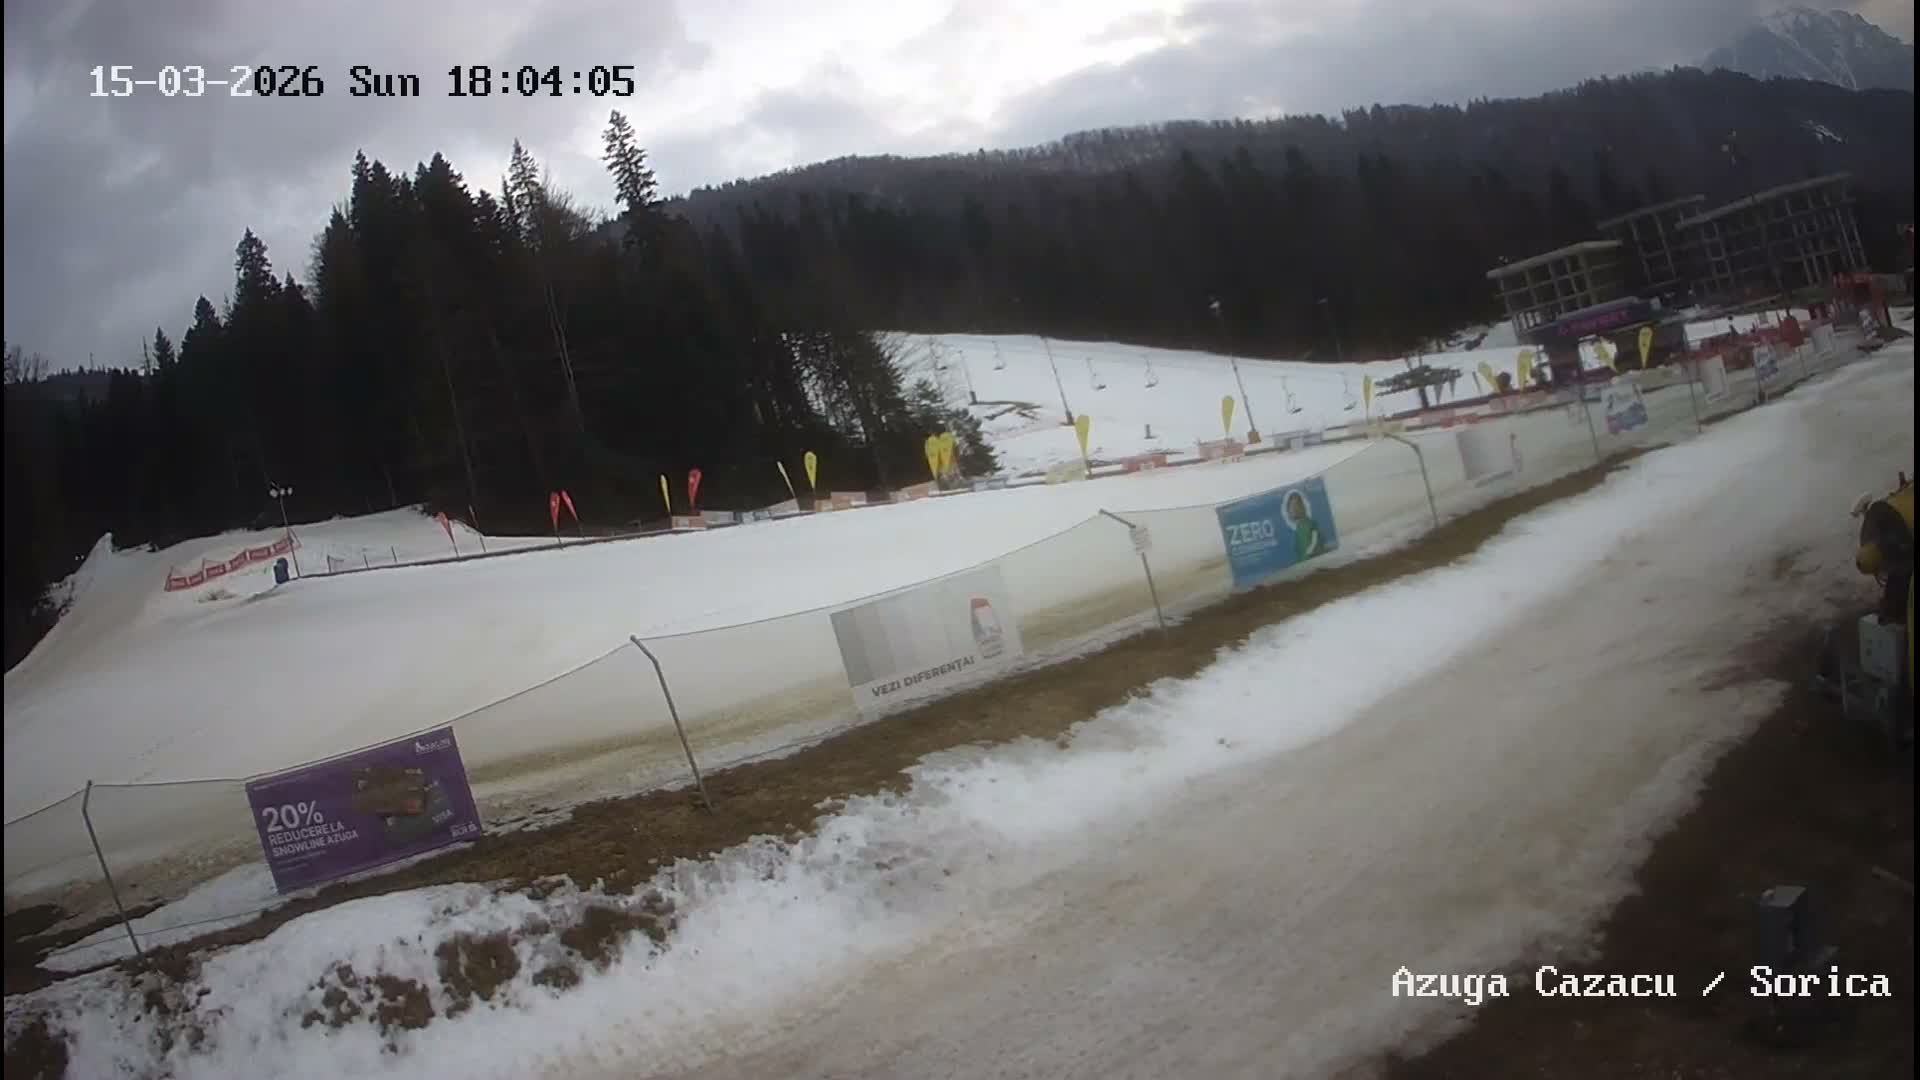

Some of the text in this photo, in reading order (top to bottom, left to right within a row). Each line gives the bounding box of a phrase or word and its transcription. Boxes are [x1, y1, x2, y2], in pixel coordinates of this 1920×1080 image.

[1226, 519, 1274, 545] ZERO
[871, 680, 901, 696] VEZI
[261, 800, 324, 832] 20%
[268, 821, 345, 846] REDUCERE LA
[272, 830, 359, 857] SNOWLINE AZUGA
